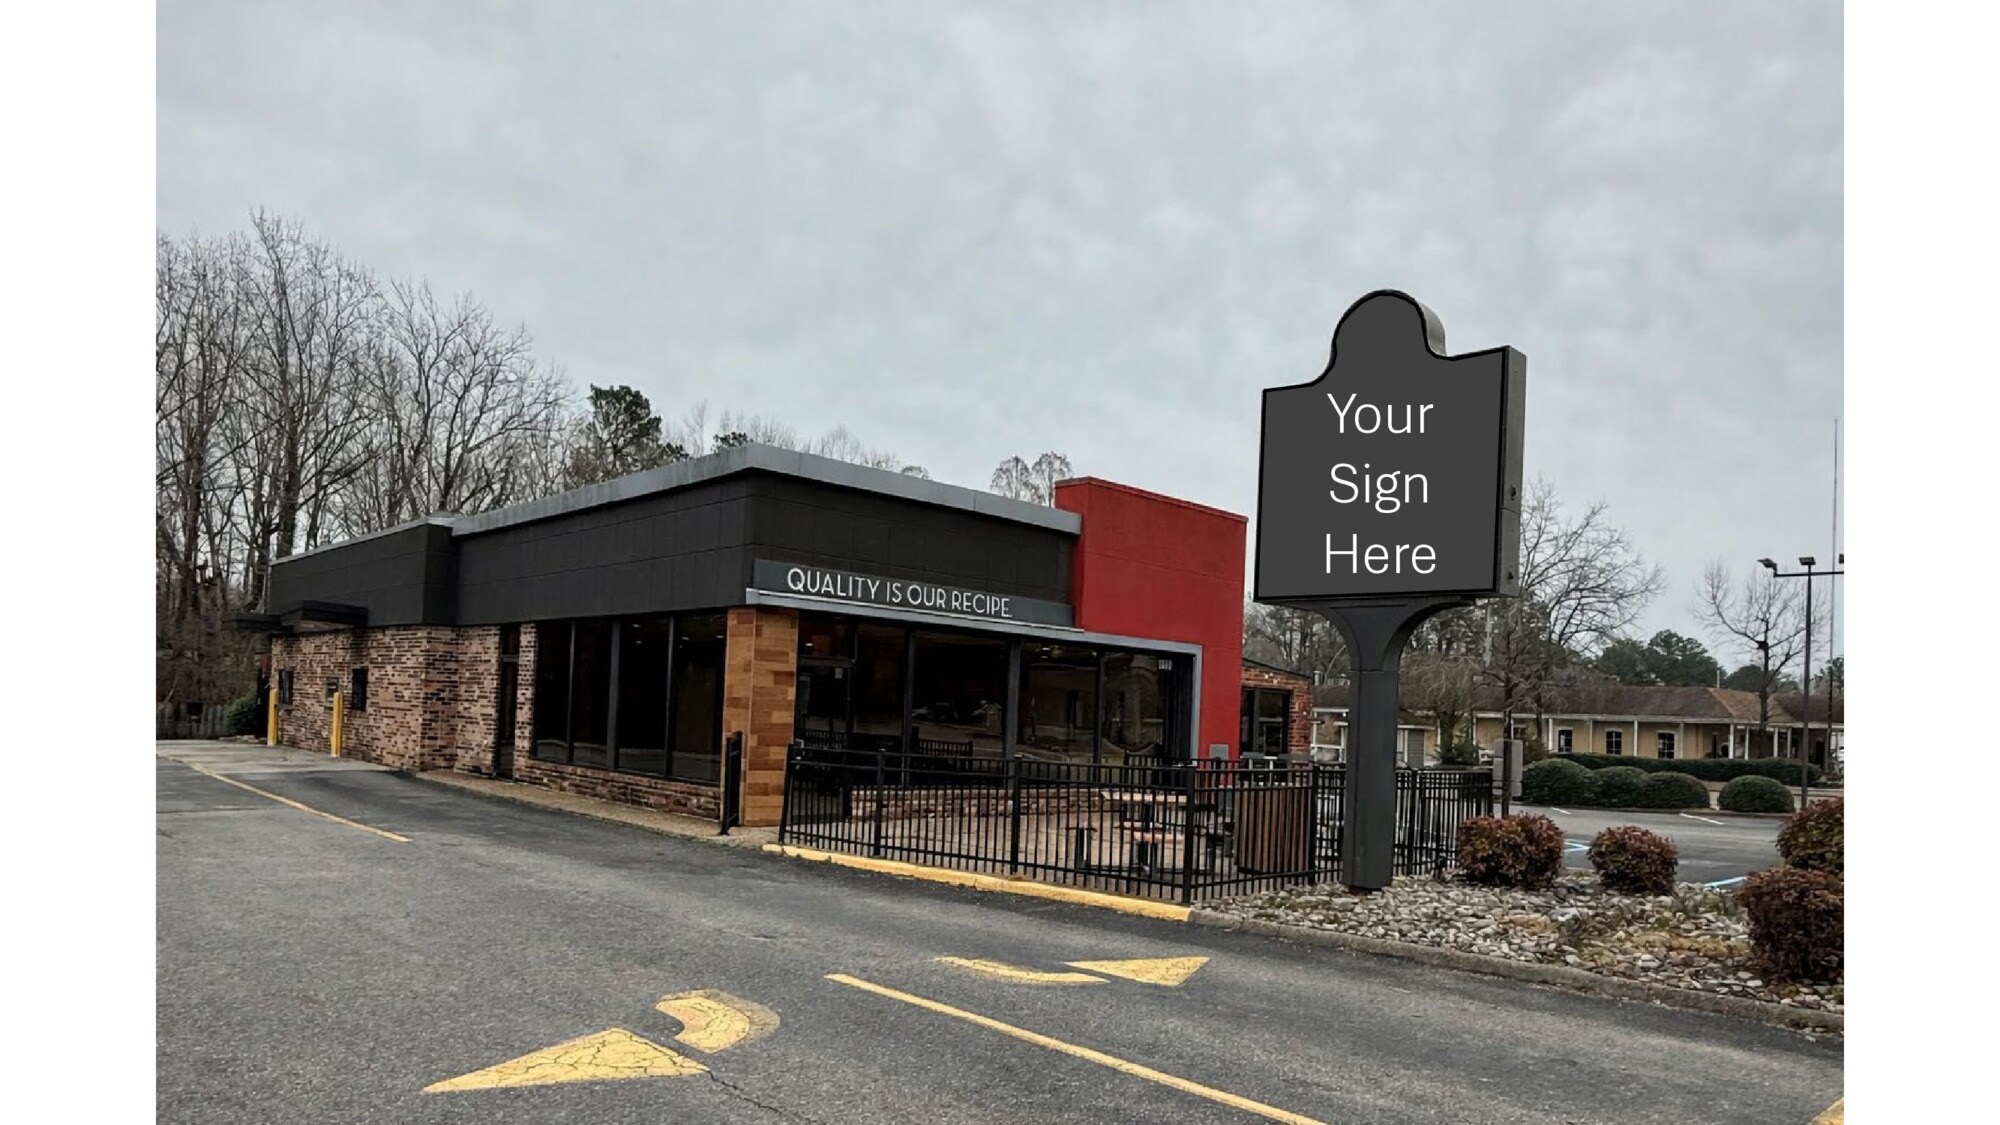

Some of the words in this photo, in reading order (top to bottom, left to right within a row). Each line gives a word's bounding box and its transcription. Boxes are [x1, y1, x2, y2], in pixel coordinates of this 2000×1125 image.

[787, 568, 880, 600] QUALITY
[886, 582, 902, 603] IS
[907, 584, 946, 609] OUR
[951, 590, 1013, 617] RECIPE
